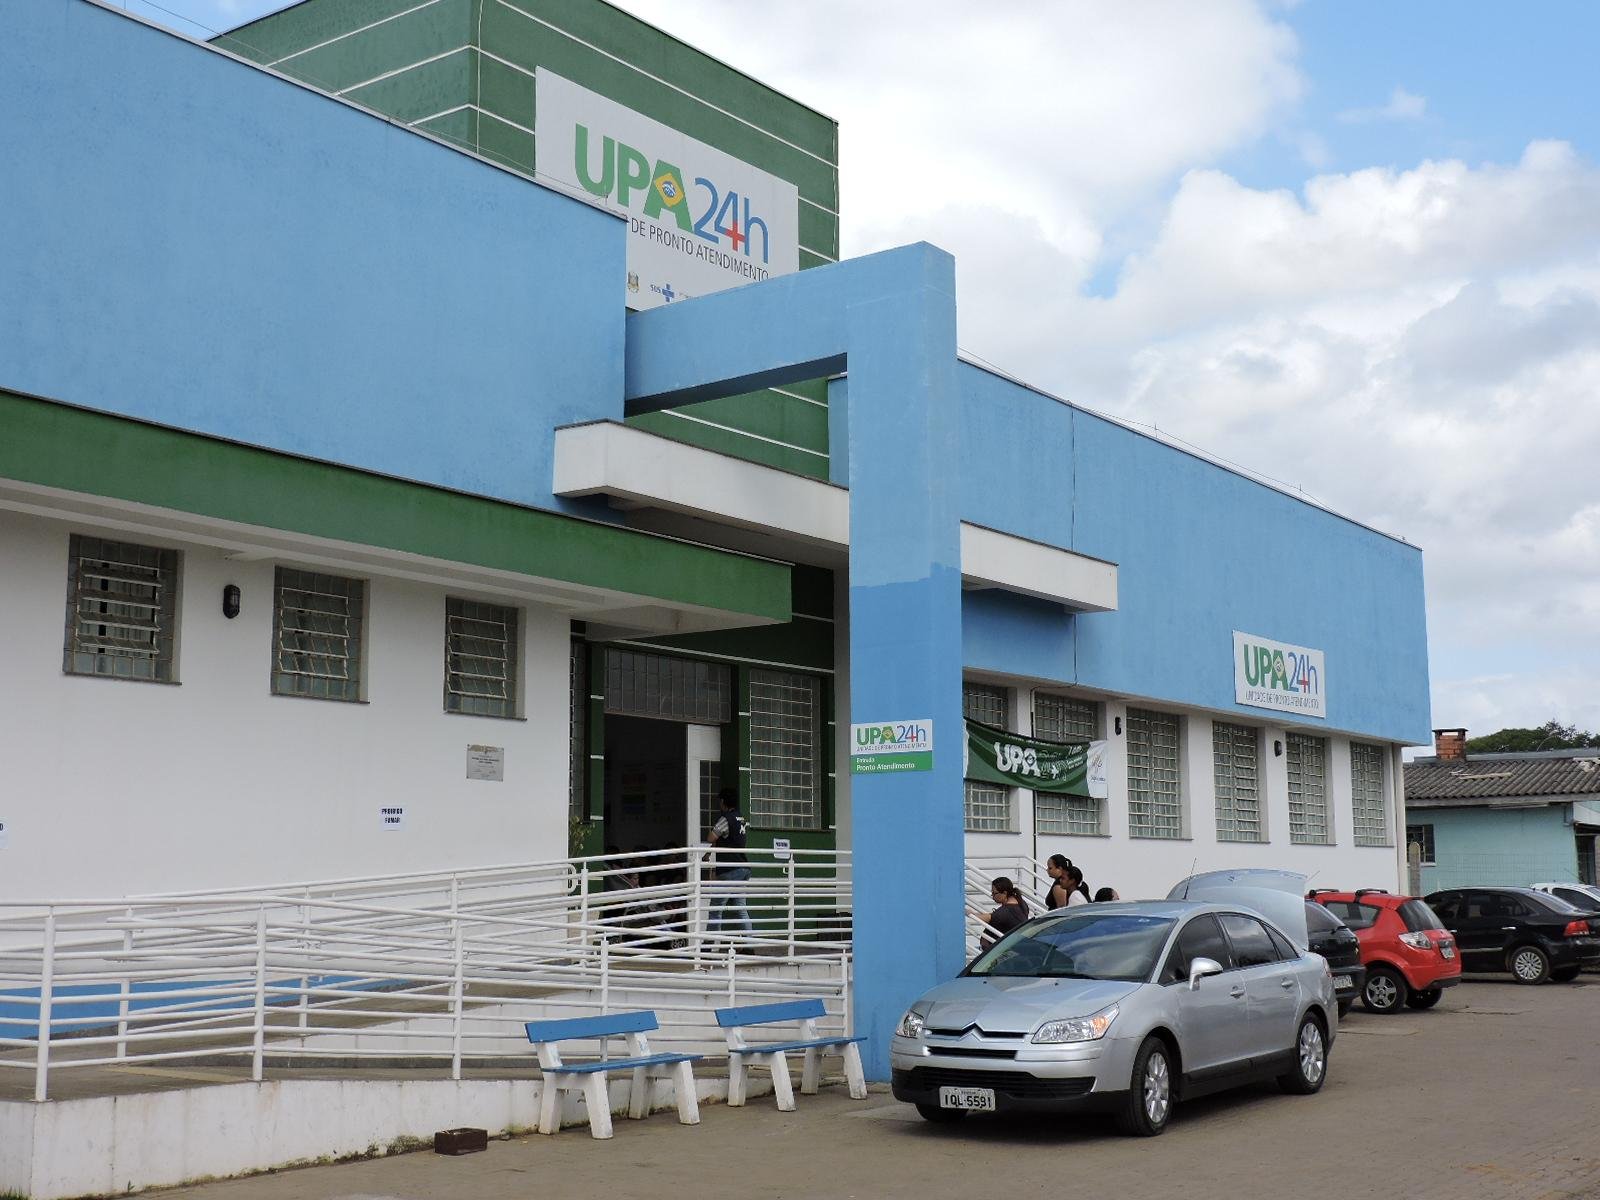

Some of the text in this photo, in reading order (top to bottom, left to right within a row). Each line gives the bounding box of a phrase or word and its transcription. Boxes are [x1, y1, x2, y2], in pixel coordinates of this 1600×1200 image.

[575, 122, 769, 265] UPA 24h
[631, 218, 769, 281] DE PRONTO ATENDIMENTO
[1243, 644, 1318, 694] UPA 24h
[856, 724, 926, 746] UPA 24h
[877, 762, 915, 770] Atendimento
[993, 741, 1041, 777] UPA
